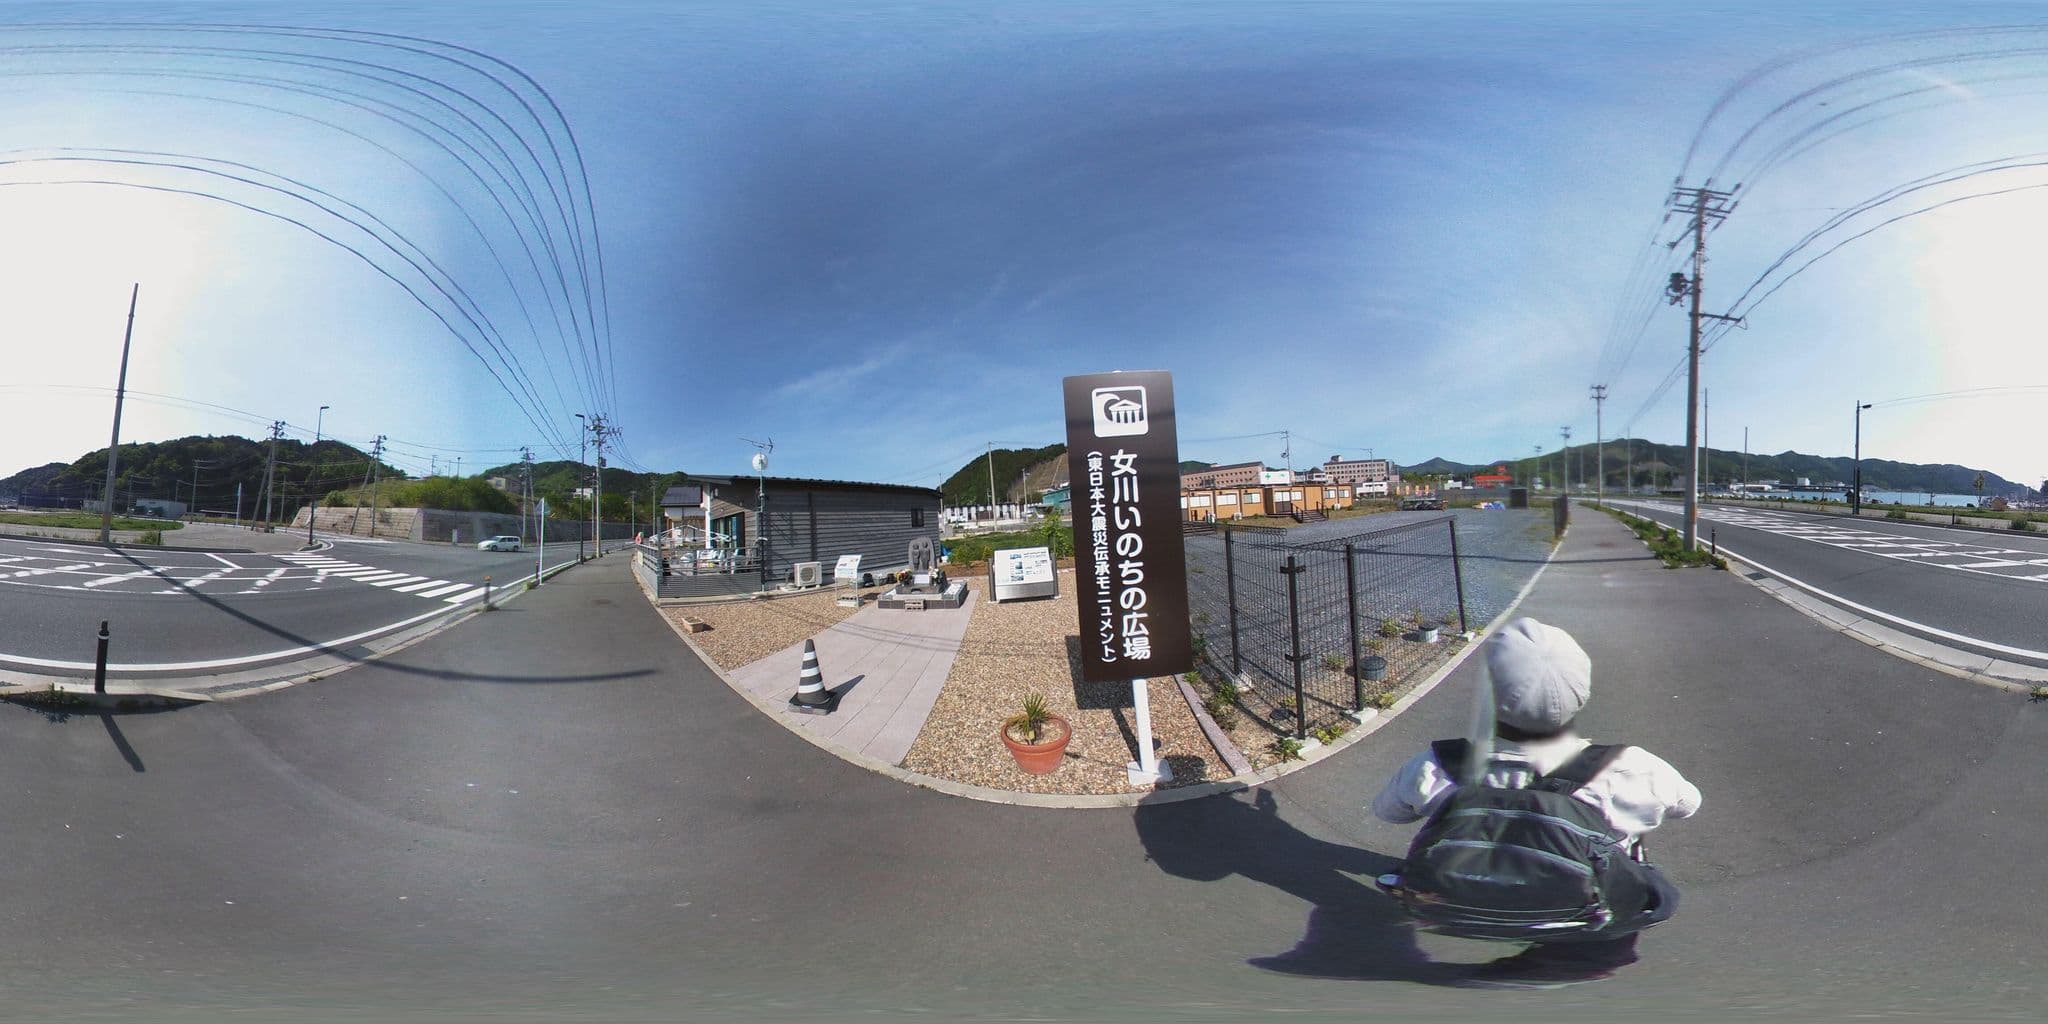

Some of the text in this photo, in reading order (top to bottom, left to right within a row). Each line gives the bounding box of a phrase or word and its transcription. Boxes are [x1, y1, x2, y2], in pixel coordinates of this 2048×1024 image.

[1109, 449, 1151, 660] 女川いのちの広場
